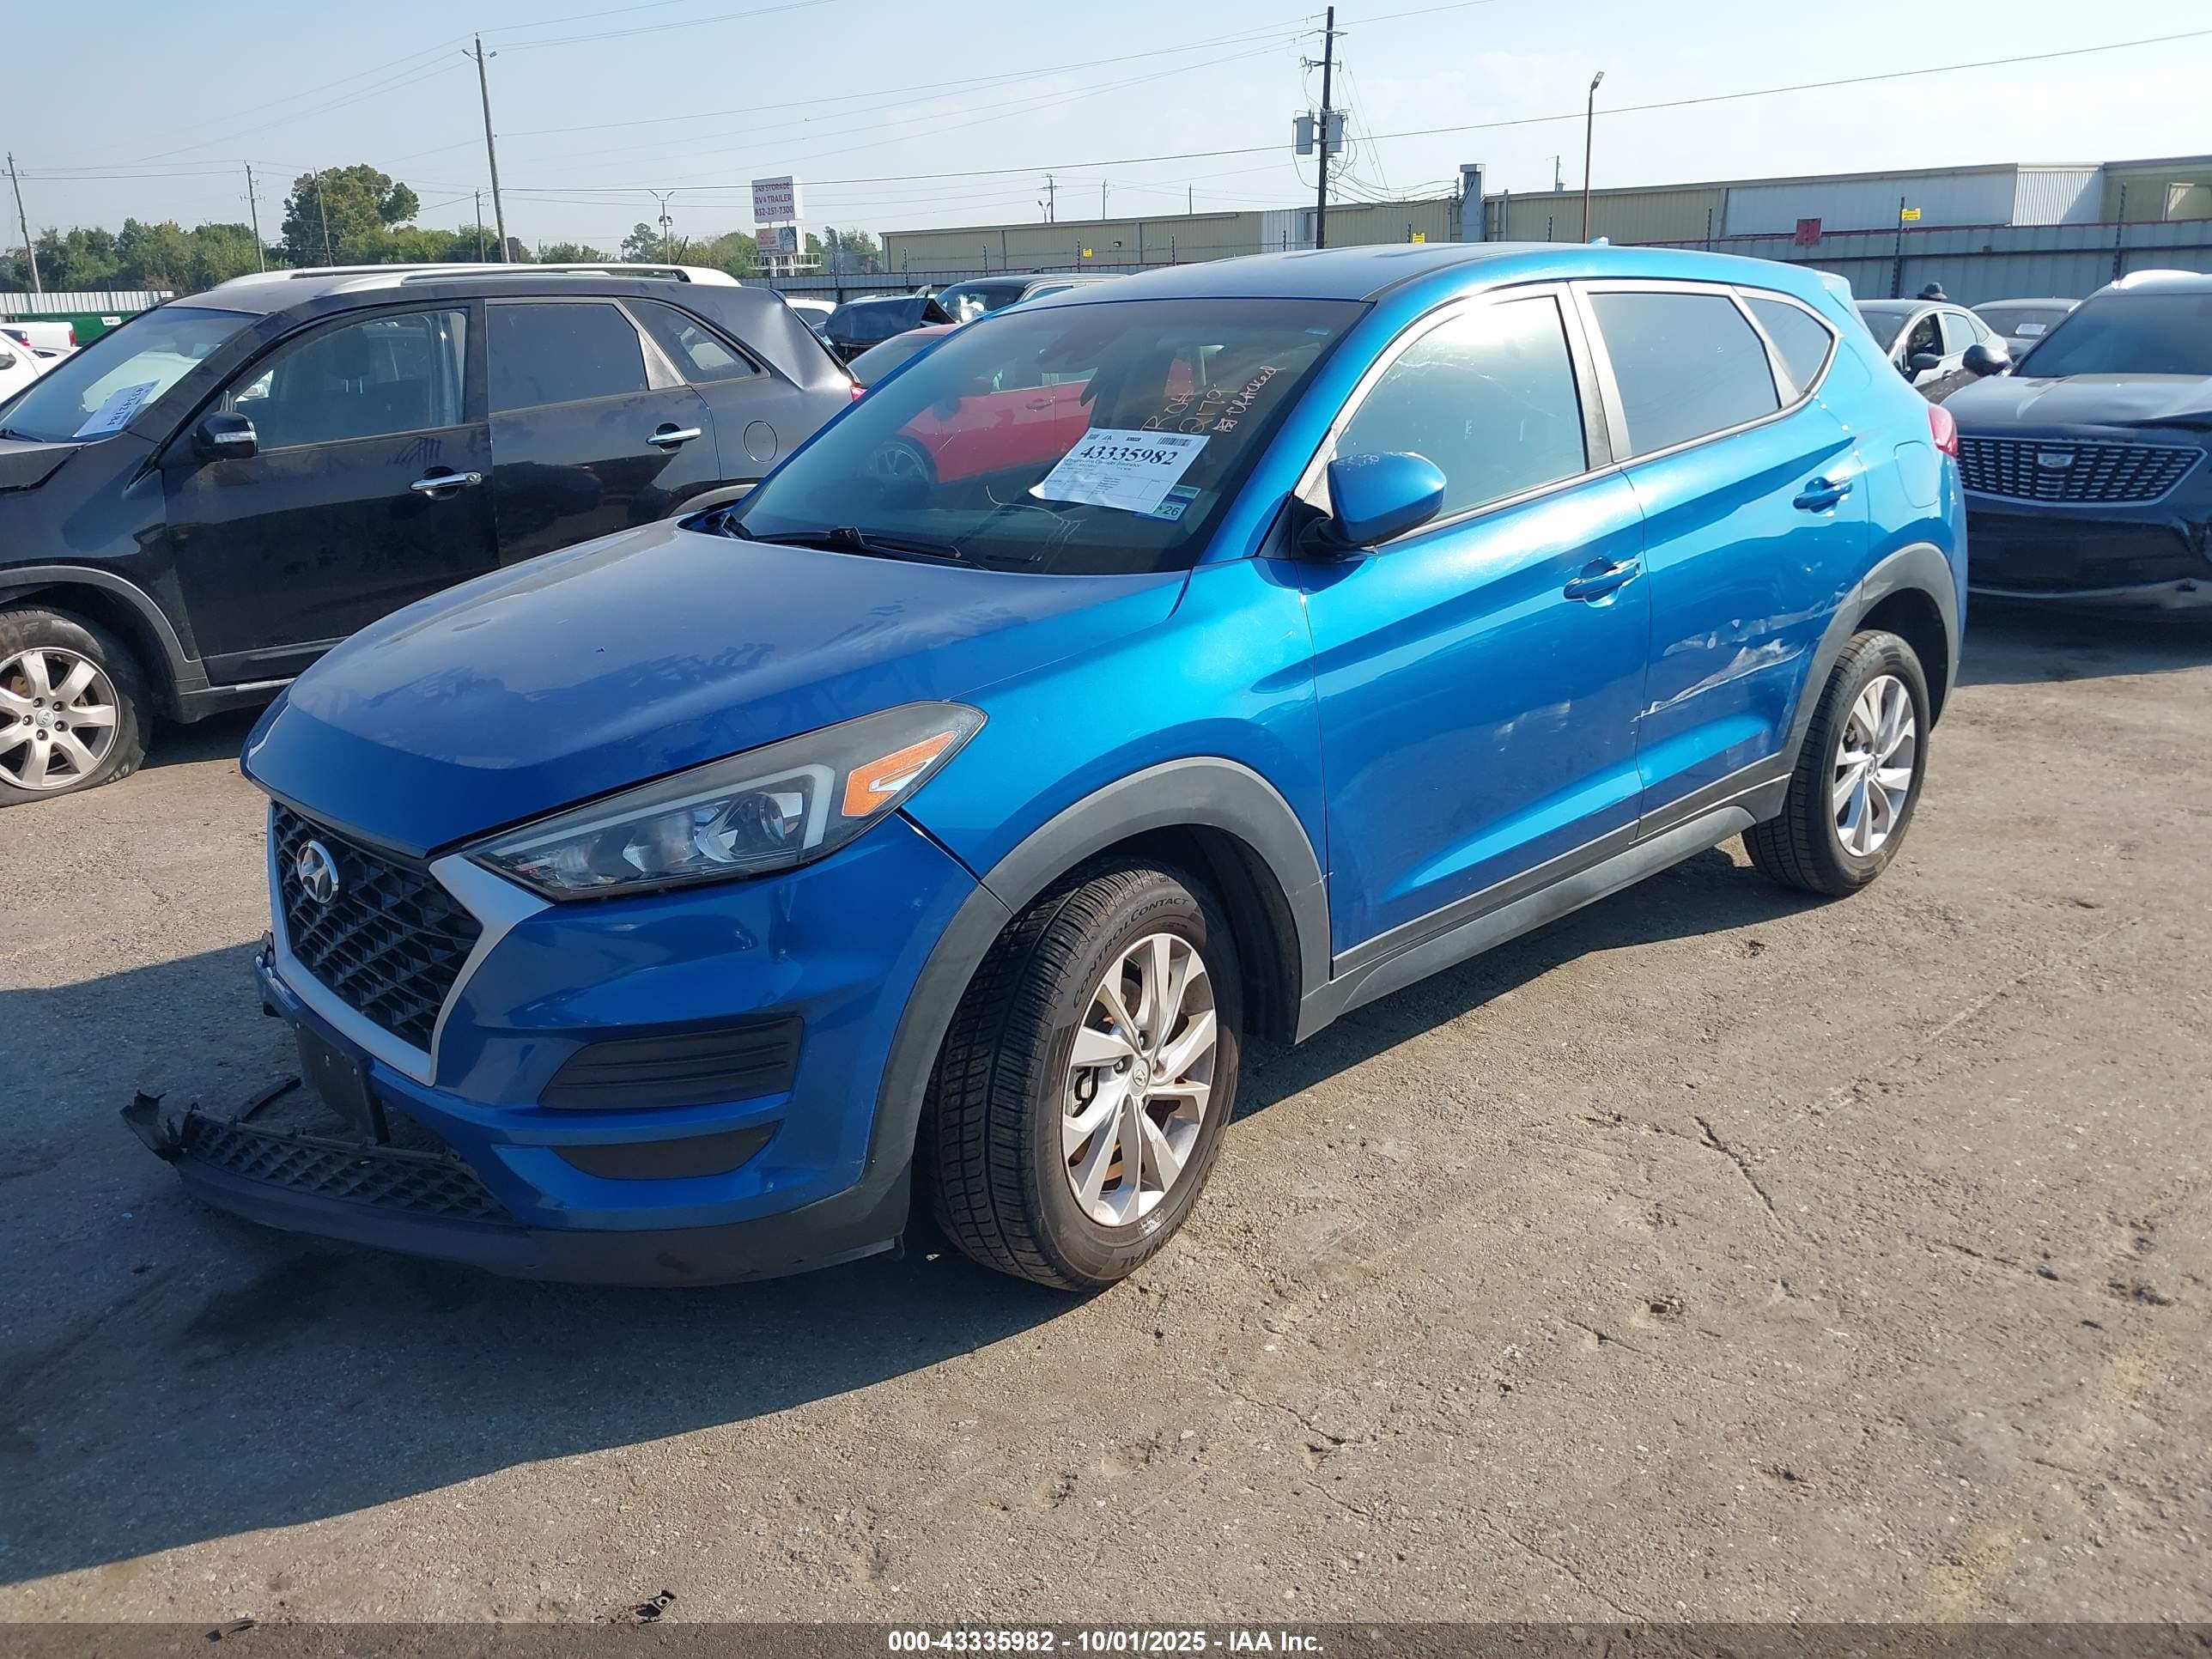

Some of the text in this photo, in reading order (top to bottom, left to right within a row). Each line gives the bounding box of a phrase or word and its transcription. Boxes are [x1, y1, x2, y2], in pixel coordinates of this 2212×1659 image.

[755, 196, 763, 204] RV
[767, 194, 792, 203] TRAILER
[1079, 445, 1178, 465] 43335982
[1163, 506, 1181, 516] 26
[40, 712, 51, 725] KIA
